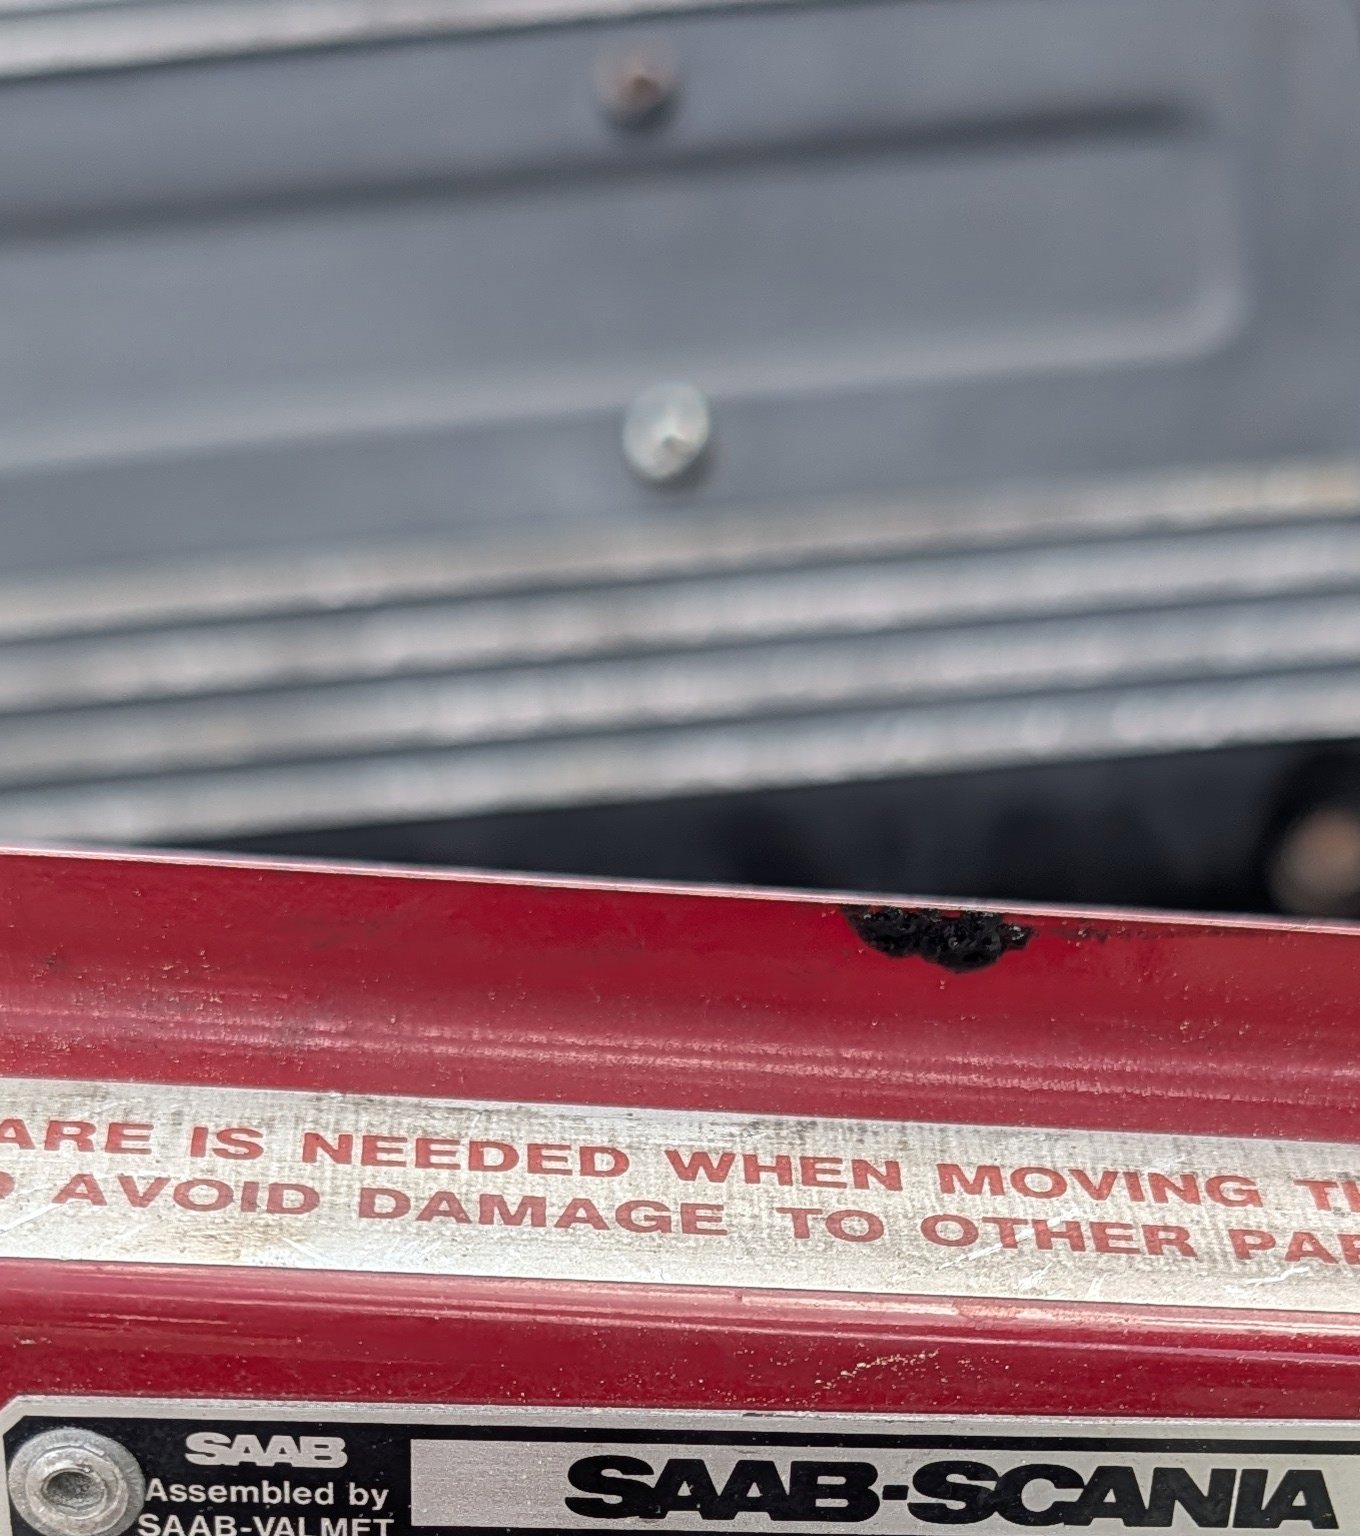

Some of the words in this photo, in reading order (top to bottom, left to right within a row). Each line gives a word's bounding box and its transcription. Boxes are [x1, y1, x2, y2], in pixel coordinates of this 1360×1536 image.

[190, 1126, 262, 1159] IS
[302, 1132, 629, 1177] NEEDED
[667, 1150, 901, 1190] WHEN
[938, 1163, 1263, 1207] MOVING
[53, 1173, 320, 1214] AVOID
[358, 1187, 726, 1236] DAMAGE
[778, 1207, 884, 1242] TO
[922, 1214, 1195, 1257] OTHER
[185, 1432, 347, 1468] SAAB
[145, 1478, 334, 1505] Assembled
[349, 1482, 389, 1510] by
[564, 1454, 1339, 1530] SAAB-SCANIA
